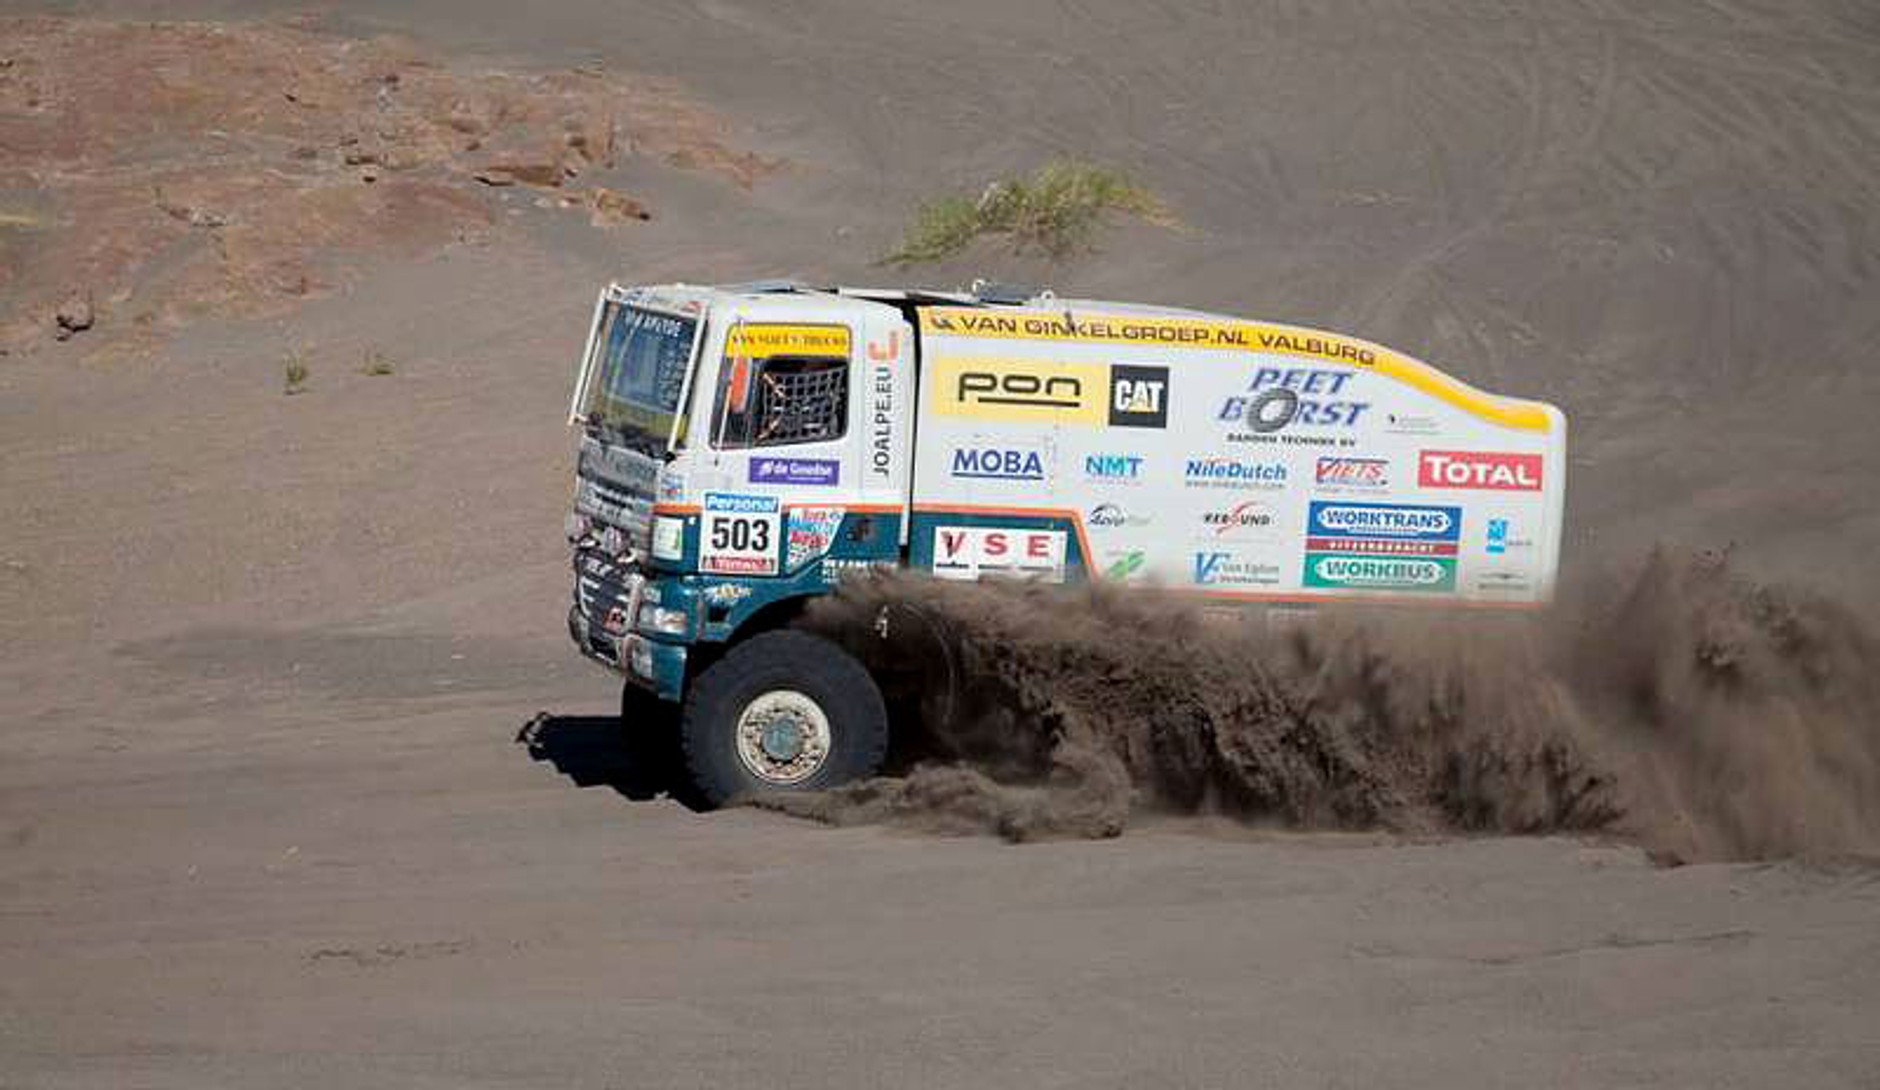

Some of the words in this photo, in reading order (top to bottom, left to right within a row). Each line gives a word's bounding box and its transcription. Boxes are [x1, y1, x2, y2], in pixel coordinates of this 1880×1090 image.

[961, 316, 1017, 333] VAN
[1257, 333, 1376, 366] VALBURG
[1250, 367, 1355, 395] PEET
[1115, 378, 1165, 414] CAT
[1217, 388, 1370, 432] BORST
[873, 366, 892, 476] JOALPE.EU
[953, 448, 1044, 476] MOBA
[1085, 455, 1144, 478] NMT
[1186, 458, 1288, 481] NileDutch
[1424, 455, 1538, 487] TOTAL
[706, 496, 777, 513] Personal
[1326, 508, 1445, 531] WORKTRANS
[712, 517, 770, 551] 503
[1325, 559, 1436, 581] WORKBUS
